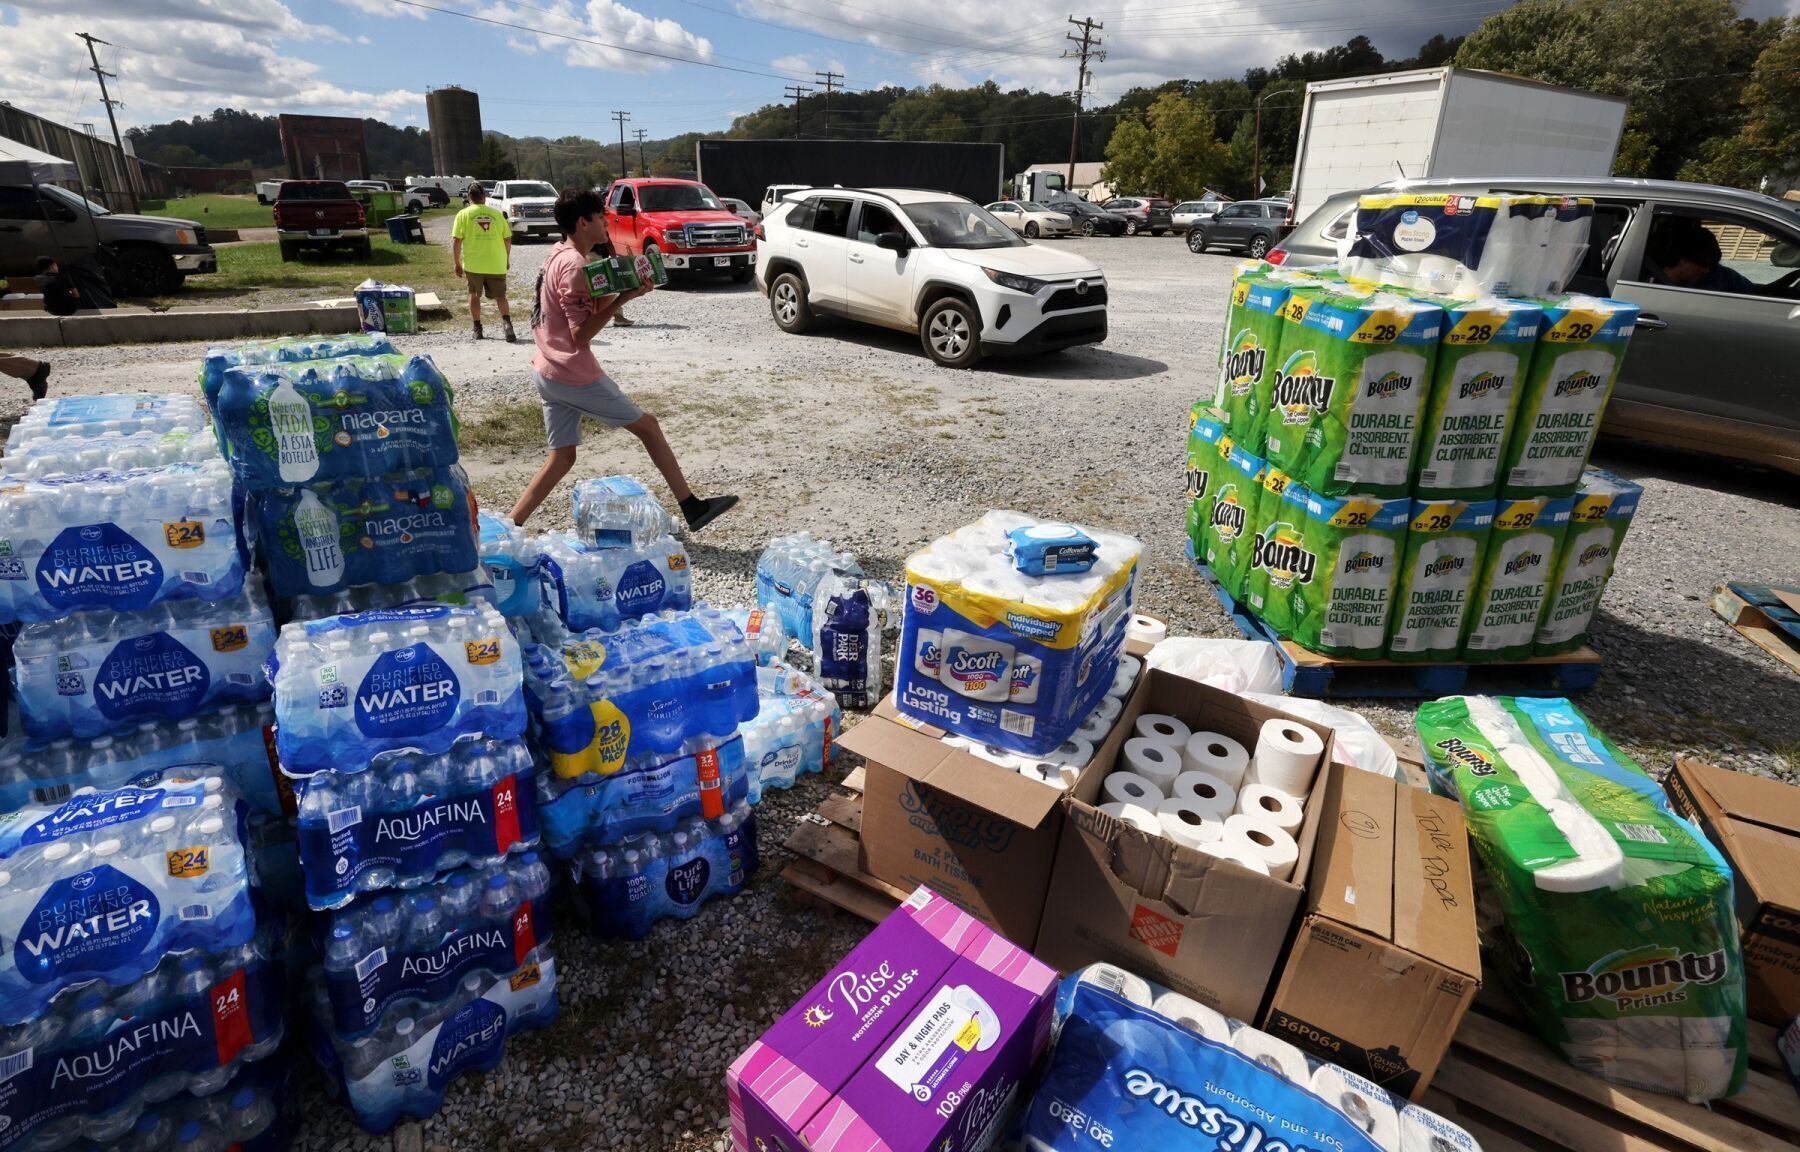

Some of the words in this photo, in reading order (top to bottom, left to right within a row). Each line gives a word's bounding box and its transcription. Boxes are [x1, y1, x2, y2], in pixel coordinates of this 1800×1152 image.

[1292, 304, 1304, 321] 28
[1374, 325, 1397, 341] 28
[1467, 325, 1492, 341] 28
[1567, 323, 1593, 340] 28
[413, 386, 428, 396] 24
[1367, 375, 1413, 398] Bounty
[1460, 375, 1504, 399] Bounty
[1554, 374, 1601, 397] Bounty
[273, 416, 310, 433] VIDA
[341, 408, 426, 430] niagara
[1351, 414, 1415, 429] DURABLE.
[1443, 414, 1505, 431] DURABLE.
[1536, 413, 1595, 429] DURABLE.
[281, 436, 289, 450] A
[1439, 432, 1500, 446] ABSORBENT.
[1531, 431, 1588, 445] ABSORBENT.
[281, 451, 316, 465] BOTELLA
[1436, 447, 1497, 461] CLOTHLIKE.
[1527, 446, 1585, 460] CLOTHLIKE.
[434, 490, 449, 500] 24
[366, 511, 445, 536] niagara
[1347, 512, 1367, 525] 28
[1430, 515, 1452, 530] 28
[1514, 512, 1535, 526] 28
[179, 526, 203, 541] 24
[54, 543, 132, 558] PURIFIED
[305, 537, 337, 549] ANOTHER
[54, 552, 137, 568] DRINKING
[308, 545, 340, 572] LIFE
[1344, 555, 1384, 574] Bounty
[1424, 556, 1465, 578] Bounty
[1504, 553, 1542, 576] Bounty
[40, 559, 155, 590] WATER
[617, 579, 664, 601] WATER
[914, 586, 935, 604] 36
[1332, 588, 1388, 601] DURABLE.
[1412, 590, 1465, 605] DURABLE.
[1491, 584, 1544, 602] DURABLE.
[1330, 602, 1385, 614] ABSORBENT.
[1408, 604, 1461, 616] ABSORBENT.
[1007, 613, 1062, 631] Individually
[1010, 622, 1055, 637] Wrapped
[225, 629, 247, 643] 24
[477, 641, 499, 656] 24
[837, 632, 850, 661] PARK
[848, 634, 859, 662] DEER
[110, 650, 184, 671] PURIFIED
[110, 658, 187, 679] DRINKING
[954, 650, 1001, 671] Scott
[371, 671, 442, 693] DRINKING
[372, 662, 440, 684] PURIFIED
[98, 665, 204, 700] WATER
[964, 680, 986, 691] 1100
[360, 679, 455, 713] WATER
[908, 681, 950, 707] Long
[902, 692, 962, 725] Lasting
[967, 705, 978, 719] 3
[977, 707, 999, 720] Extra
[977, 714, 996, 724] Rolls
[598, 720, 622, 743] 28
[598, 735, 627, 756] VALUE
[600, 747, 626, 764] PACK
[700, 755, 713, 764] 32
[1434, 737, 1499, 778] Bounty
[496, 790, 513, 807] 24
[1474, 790, 1494, 810] Upper
[375, 799, 486, 843] AQUAFINA
[331, 830, 351, 844] Purified
[332, 835, 354, 850] Drinking
[727, 835, 739, 846] 28
[184, 850, 207, 867] 24
[332, 843, 349, 856] Water
[934, 847, 943, 857] 2
[944, 850, 965, 867] PLY
[673, 862, 703, 881] Pure
[913, 848, 942, 869] BATH
[943, 860, 985, 888] TISSUE
[626, 875, 647, 887] 100%
[628, 883, 650, 894] PURE
[678, 874, 702, 892] Life
[39, 885, 129, 922] PURIFIED
[1642, 895, 1697, 914] Nature
[39, 894, 133, 932] DRINKING
[516, 912, 529, 931] 24
[22, 899, 152, 958] WATER
[1131, 919, 1183, 941] HOME
[1342, 938, 1363, 950] CASE
[400, 930, 506, 979] AQUAFINA
[359, 972, 378, 986] Purified
[519, 970, 539, 983] 24
[1558, 949, 1728, 1003] Bounty
[360, 977, 381, 994] Drinking
[361, 988, 376, 999] Water
[827, 959, 895, 1016] Poise
[880, 968, 919, 1006] PLUS+
[216, 987, 240, 1012] 24
[1616, 990, 1687, 1012] Prints
[861, 1004, 879, 1022] FRESH
[894, 1048, 911, 1066] DAY
[908, 1042, 918, 1051] &
[914, 1019, 936, 1043] NIGHT
[932, 1001, 951, 1022] PADS
[1276, 1015, 1342, 1051] 36P064
[50, 1010, 202, 1089] AQUAFINA
[430, 1014, 504, 1076] WATER
[1367, 1051, 1408, 1072] TOUGH
[1372, 1062, 1399, 1076] GUY
[931, 1069, 949, 1089] ULTIMATE
[946, 1056, 959, 1071] LONG
[934, 1090, 961, 1120] 108
[958, 1081, 972, 1098] PADS
[957, 1074, 1006, 1145] Poise
[1203, 1080, 1276, 1123] Absorbent
[1048, 1101, 1087, 1129] 380
[1093, 1120, 1113, 1135] ROLLS
[1280, 1117, 1308, 1135] and
[1089, 1127, 1115, 1149] 30
[1312, 1131, 1344, 1152] Soft
